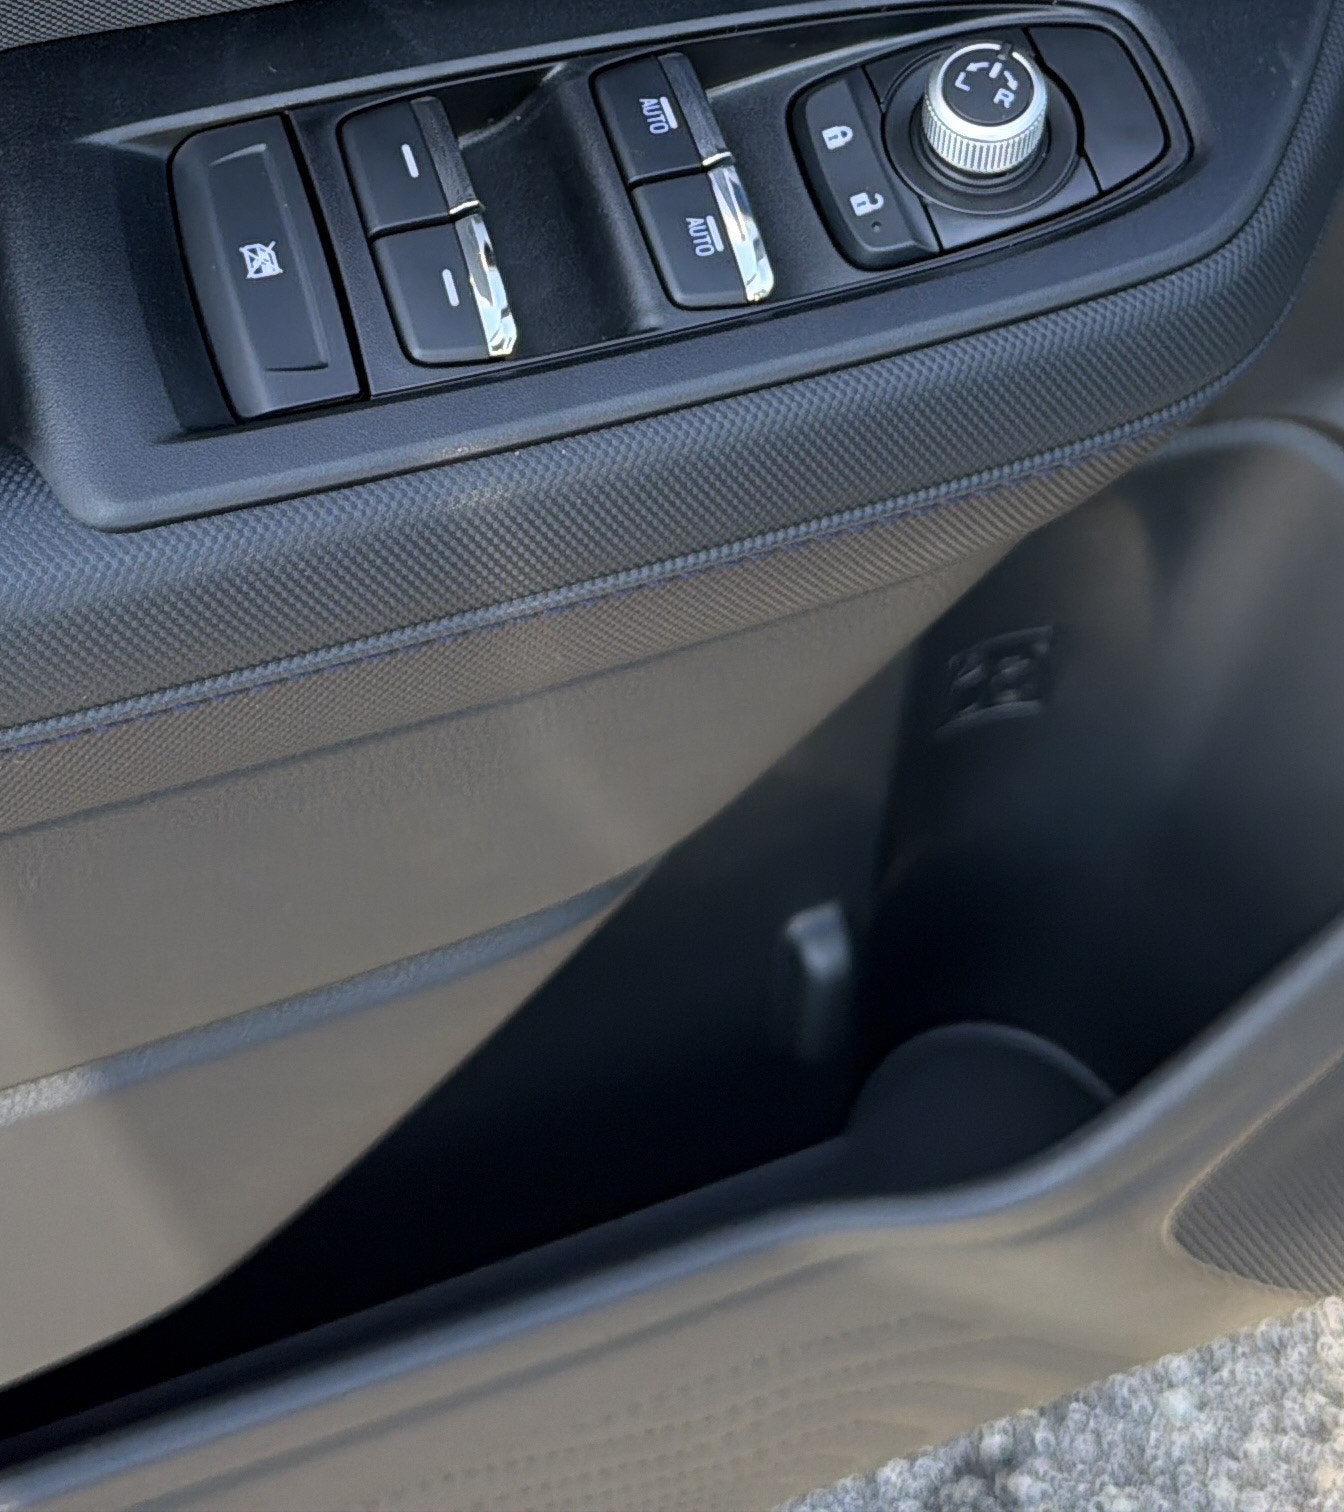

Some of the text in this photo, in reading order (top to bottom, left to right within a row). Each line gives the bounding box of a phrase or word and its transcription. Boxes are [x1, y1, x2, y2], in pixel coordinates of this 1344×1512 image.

[955, 72, 970, 91] L
[993, 88, 1014, 108] R
[639, 98, 668, 134] AUTO
[686, 217, 714, 257] AUTO
